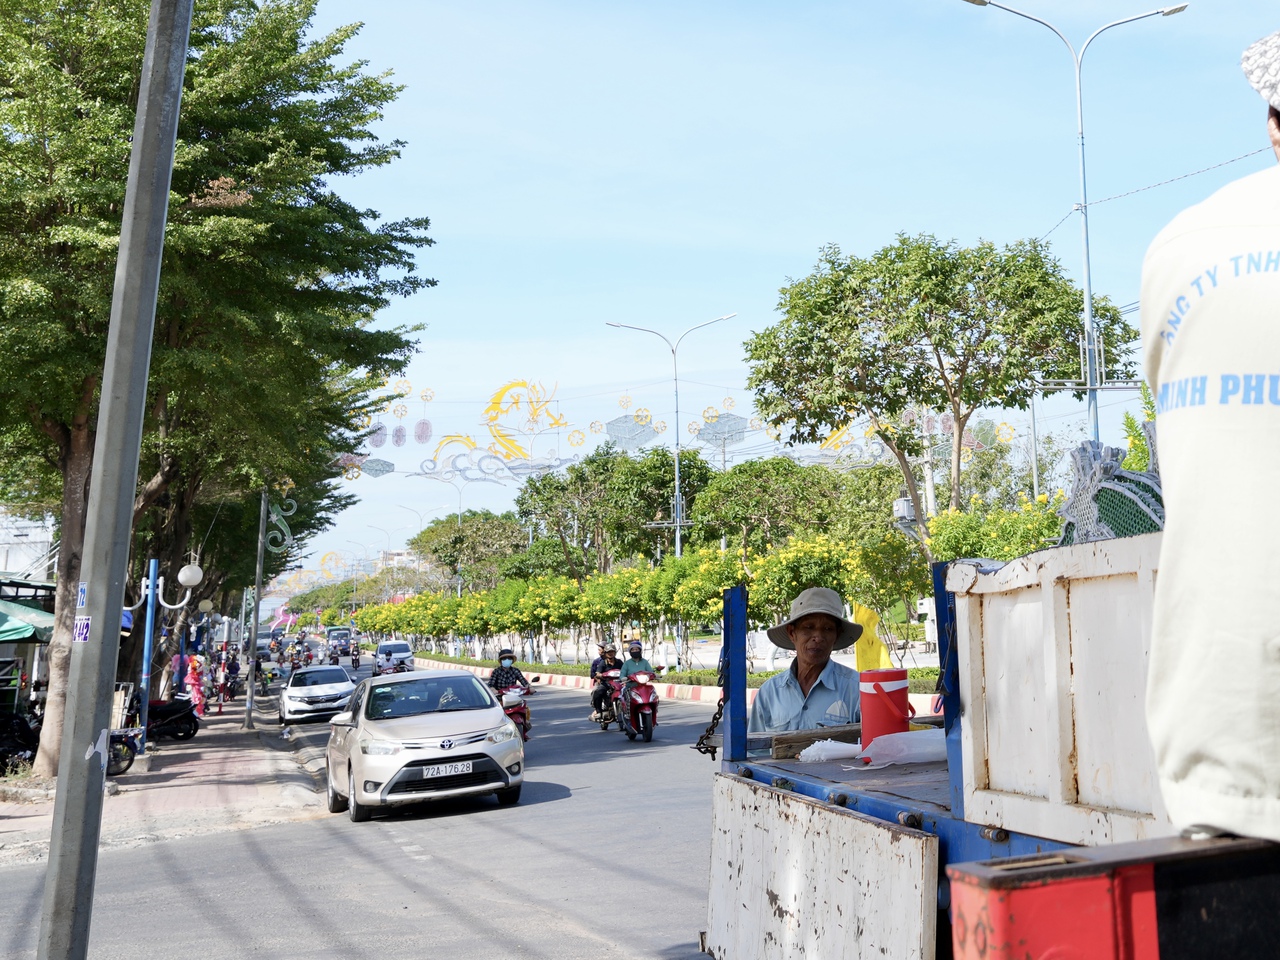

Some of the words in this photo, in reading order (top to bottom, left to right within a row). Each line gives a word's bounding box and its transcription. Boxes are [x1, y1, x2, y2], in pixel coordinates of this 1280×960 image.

[1160, 295, 1192, 350] ÔNG
[1190, 265, 1219, 297] TY
[1157, 375, 1208, 416] MINH
[425, 762, 471, 777] 72A-176.28
